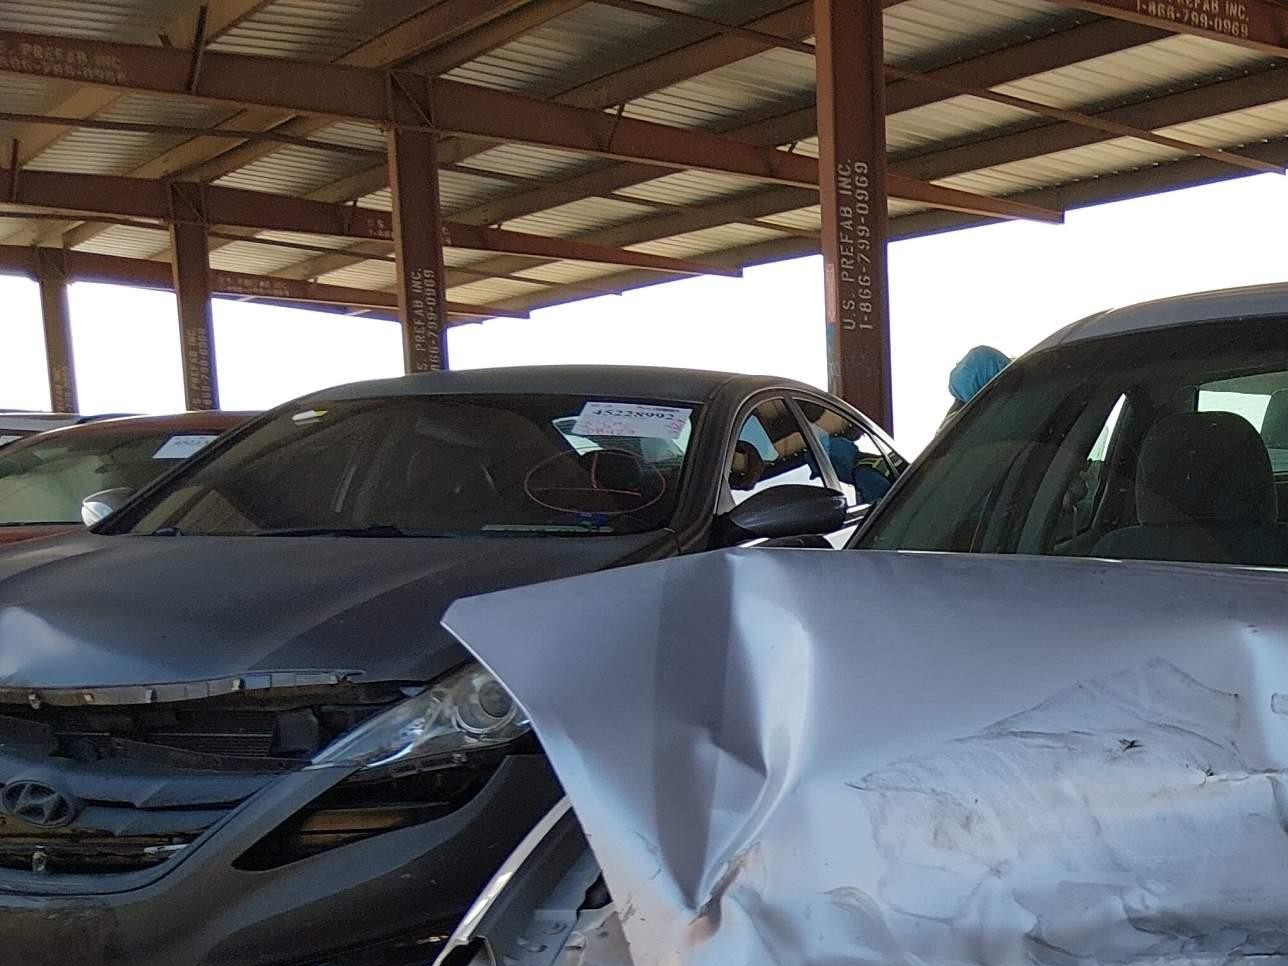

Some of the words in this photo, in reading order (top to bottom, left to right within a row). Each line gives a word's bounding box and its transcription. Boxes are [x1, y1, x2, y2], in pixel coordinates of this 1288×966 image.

[1225, 1, 1249, 22] INC.
[838, 158, 852, 196] INC.
[840, 206, 855, 282] PREFAB
[854, 161, 873, 330] 1-866-799-0969
[410, 268, 423, 293] INC.
[412, 300, 427, 351] PREFAB
[843, 294, 857, 331] U.S.
